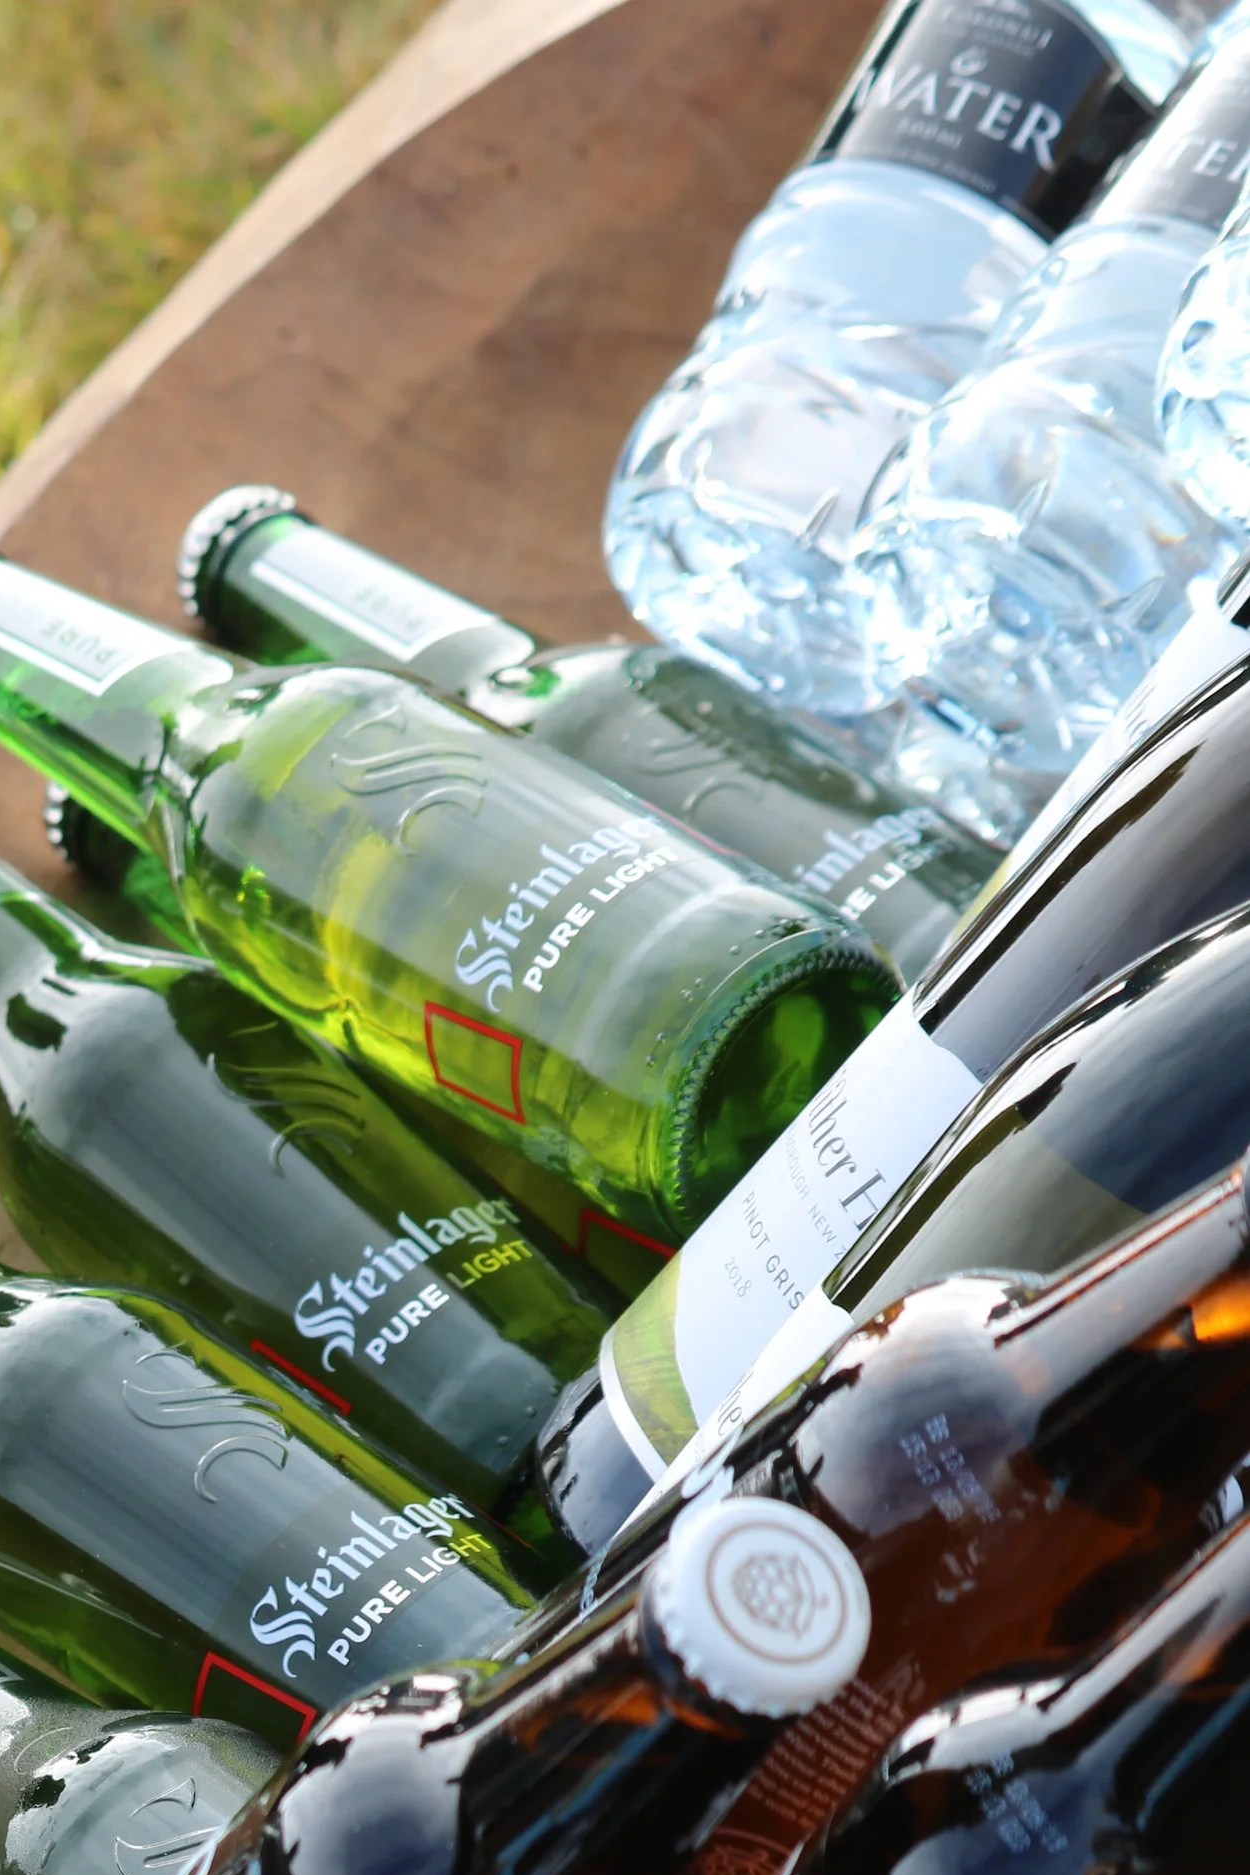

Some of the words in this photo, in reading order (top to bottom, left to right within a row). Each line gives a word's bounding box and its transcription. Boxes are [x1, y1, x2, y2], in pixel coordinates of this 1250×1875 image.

[853, 65, 1057, 174] WATER
[40, 616, 120, 664] PURE
[521, 901, 597, 994] PURE
[588, 845, 680, 904] LIGHT
[293, 1196, 521, 1374] Steinlager
[363, 1282, 450, 1366] PURE
[445, 1239, 534, 1290] LIGHT
[723, 1256, 754, 1299] 2018
[741, 1190, 772, 1251] PINOT
[764, 1254, 806, 1311] GRIS
[249, 1492, 476, 1679] Steinlager
[326, 1578, 412, 1667] PURE
[404, 1532, 493, 1585] LIGHT
